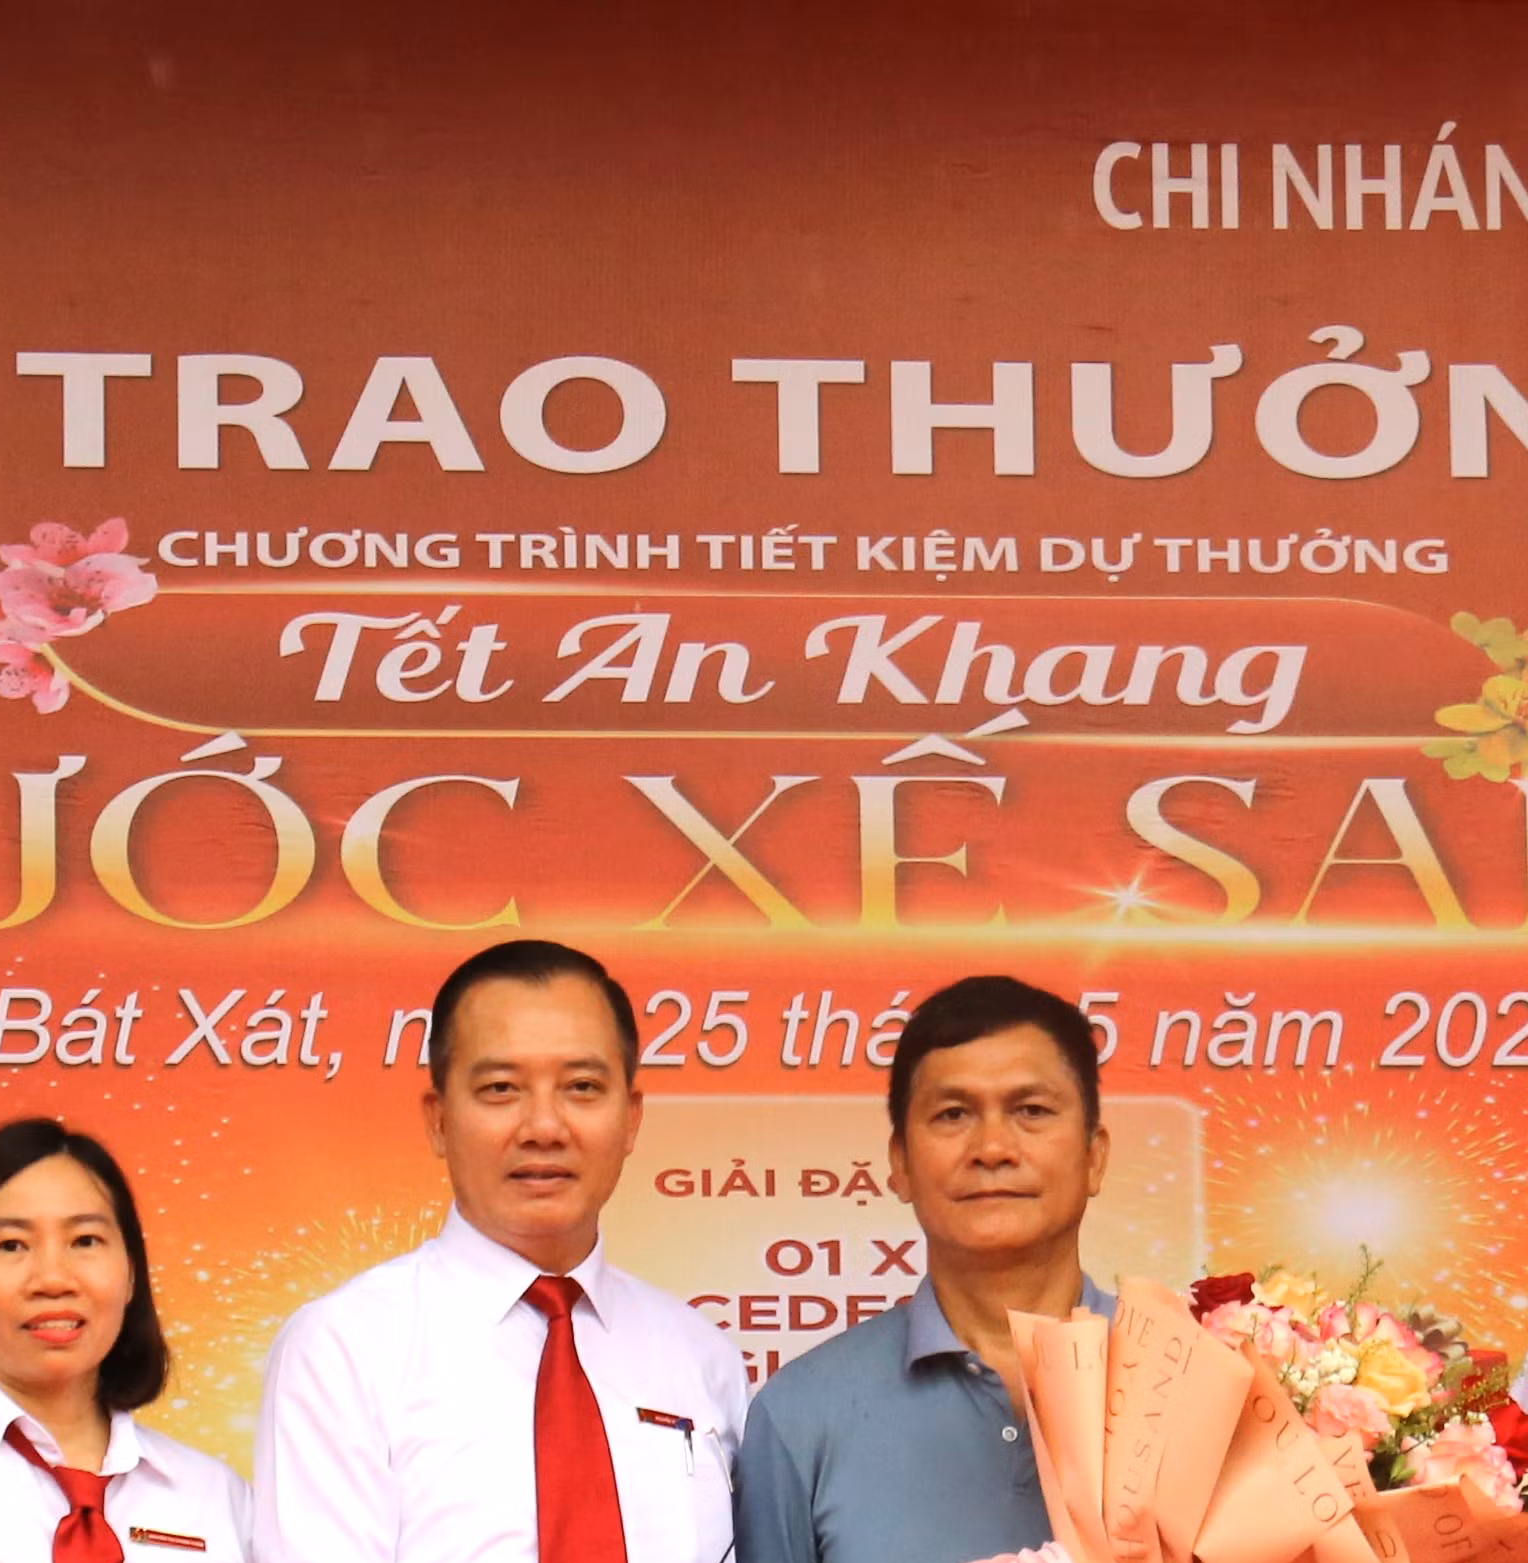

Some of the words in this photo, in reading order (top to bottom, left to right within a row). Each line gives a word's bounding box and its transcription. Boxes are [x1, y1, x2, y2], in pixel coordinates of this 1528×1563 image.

[1093, 139, 1240, 231] CHI
[15, 351, 667, 475] TRAO
[157, 527, 460, 570] CHƯƠNG
[474, 526, 682, 571] TRÌNH
[695, 525, 838, 573] TIẾT
[855, 528, 1019, 584] KIỆM
[1039, 534, 1142, 577] DỰ
[1154, 527, 1451, 575] THƯỞNG
[279, 607, 516, 706] Tết
[542, 611, 774, 706] An
[805, 615, 1307, 735] Khang
[622, 709, 1031, 932] XẾ
[164, 989, 342, 1080] Xát,
[640, 990, 749, 1066] 25
[780, 991, 913, 1067] thá
[1149, 991, 1344, 1067] năm
[654, 1159, 776, 1198] GIẢI
[765, 1239, 841, 1276] 01
[870, 1240, 919, 1276] X
